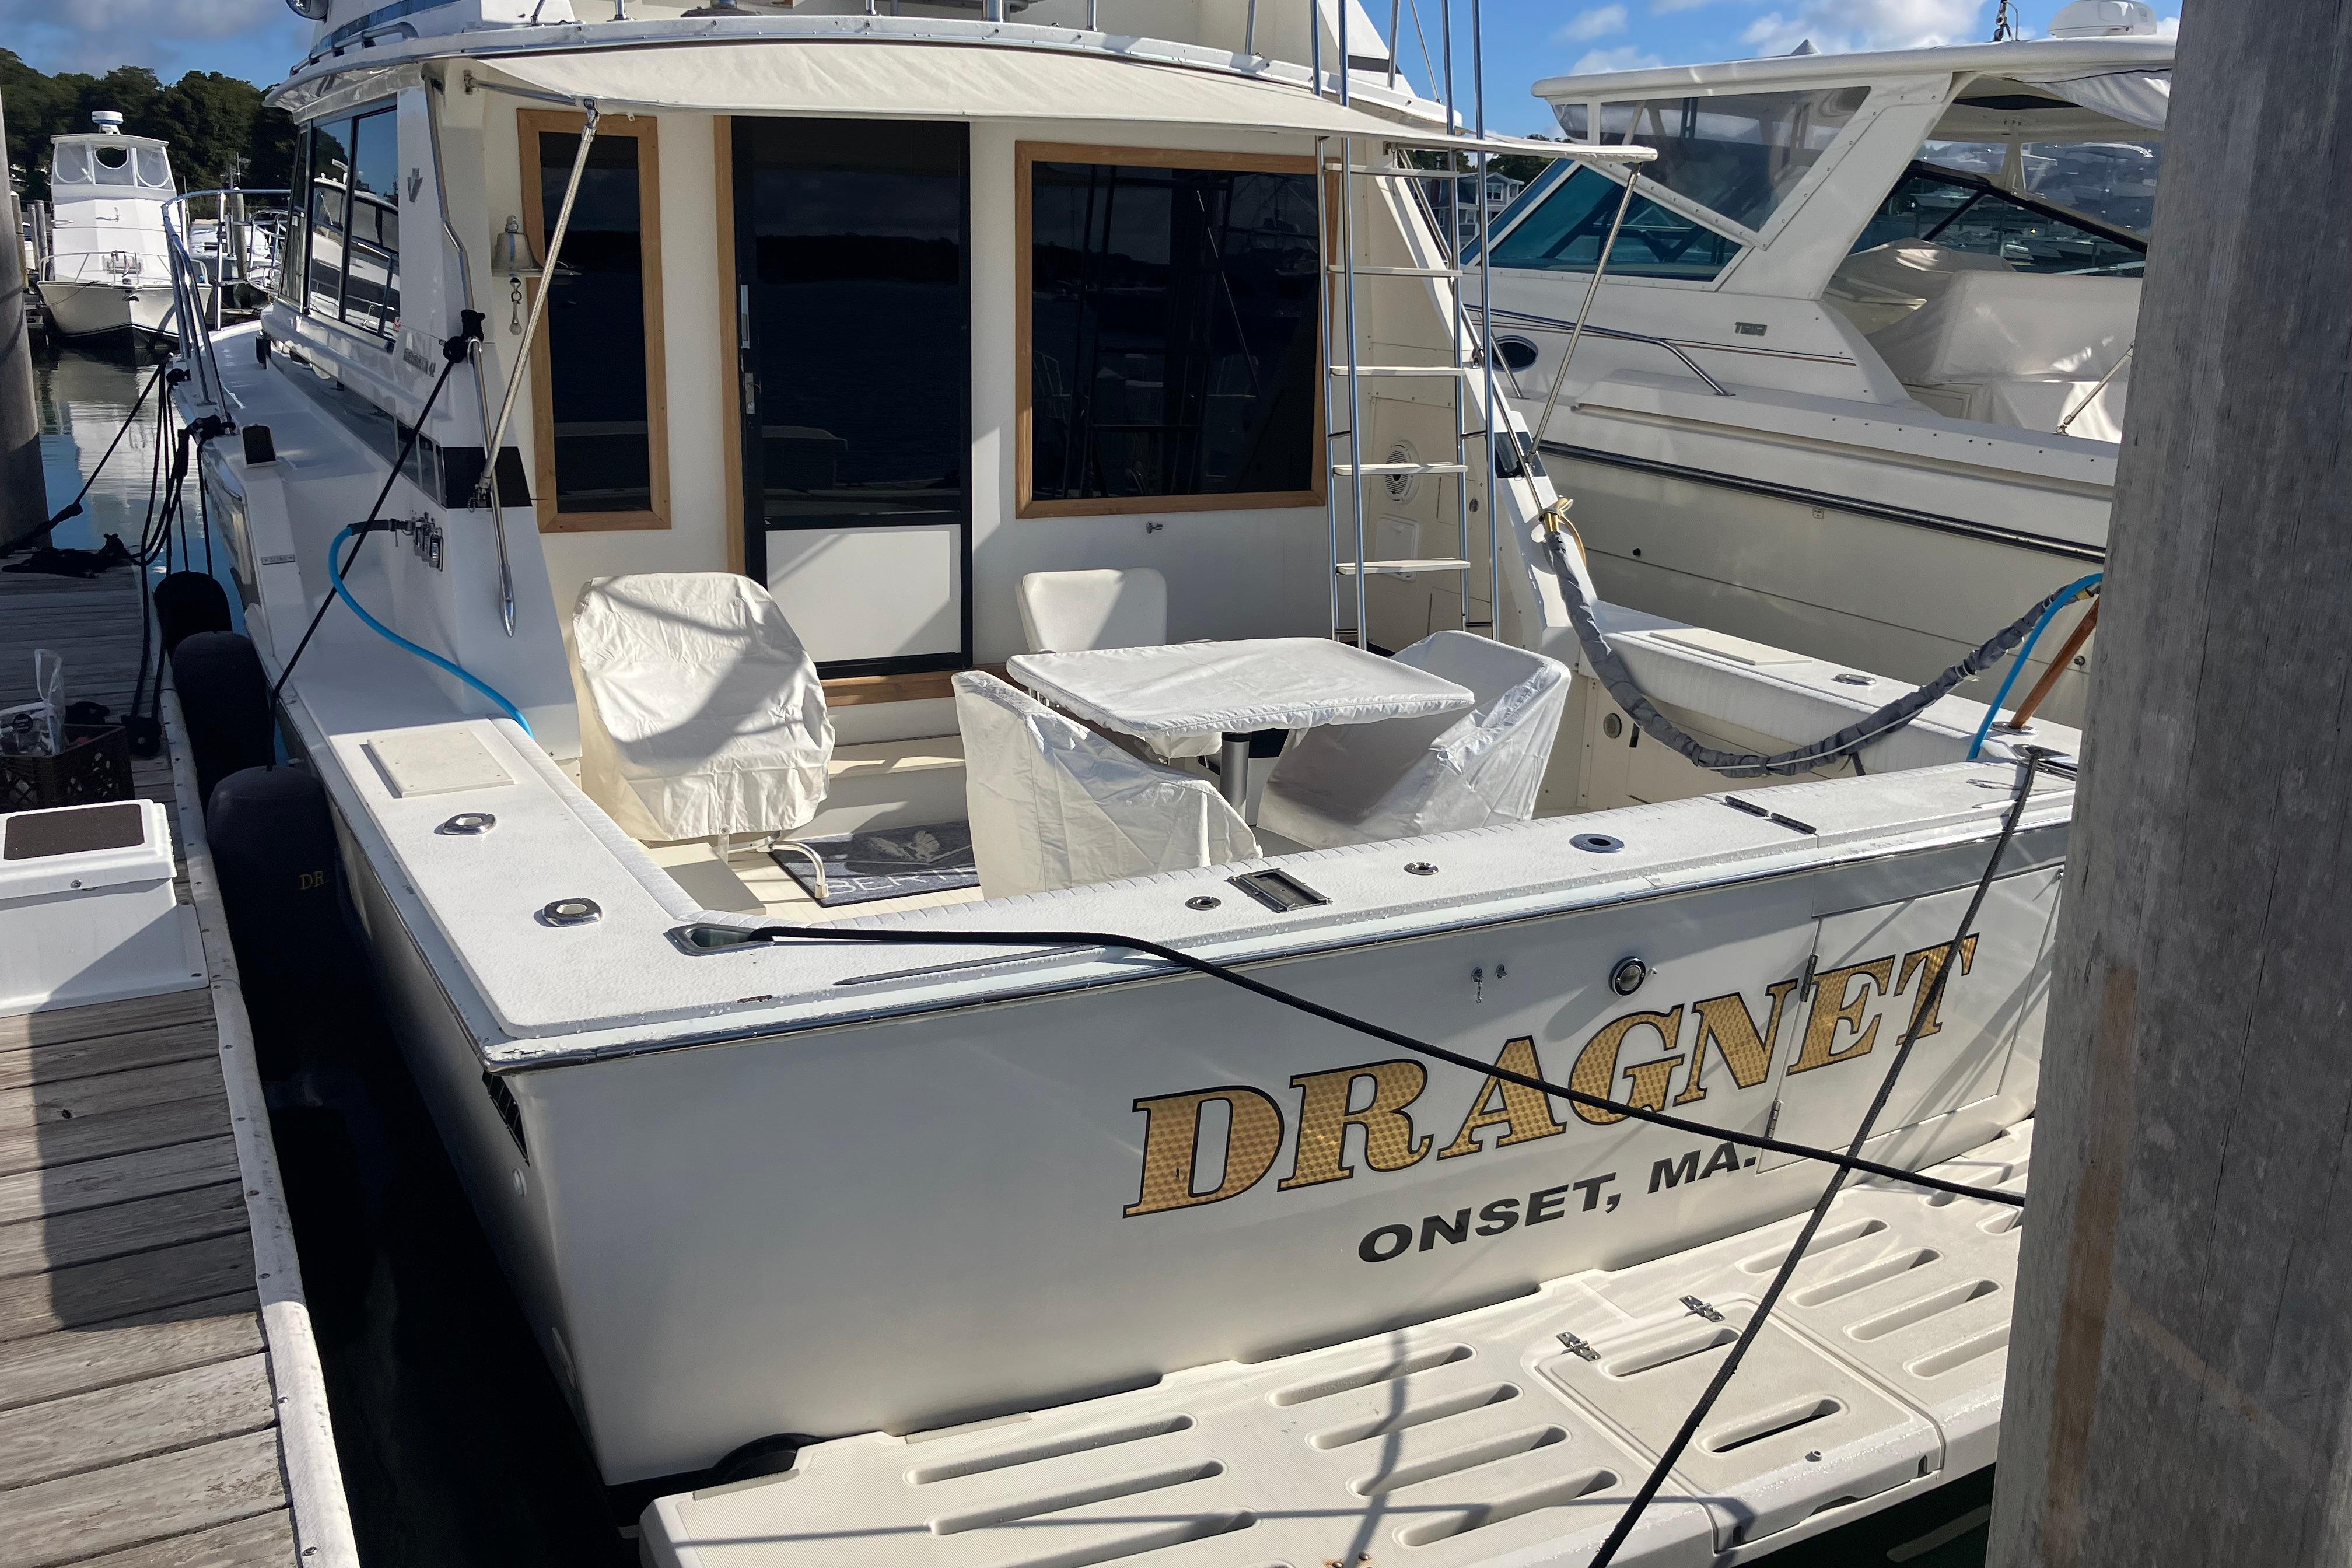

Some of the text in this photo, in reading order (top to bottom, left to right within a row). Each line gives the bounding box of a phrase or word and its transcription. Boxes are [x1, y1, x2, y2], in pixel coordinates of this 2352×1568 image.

[299, 870, 330, 890] DR
[1122, 932, 1980, 1219] DRAGNET
[1358, 1142, 1757, 1263] ONSET, MA.
